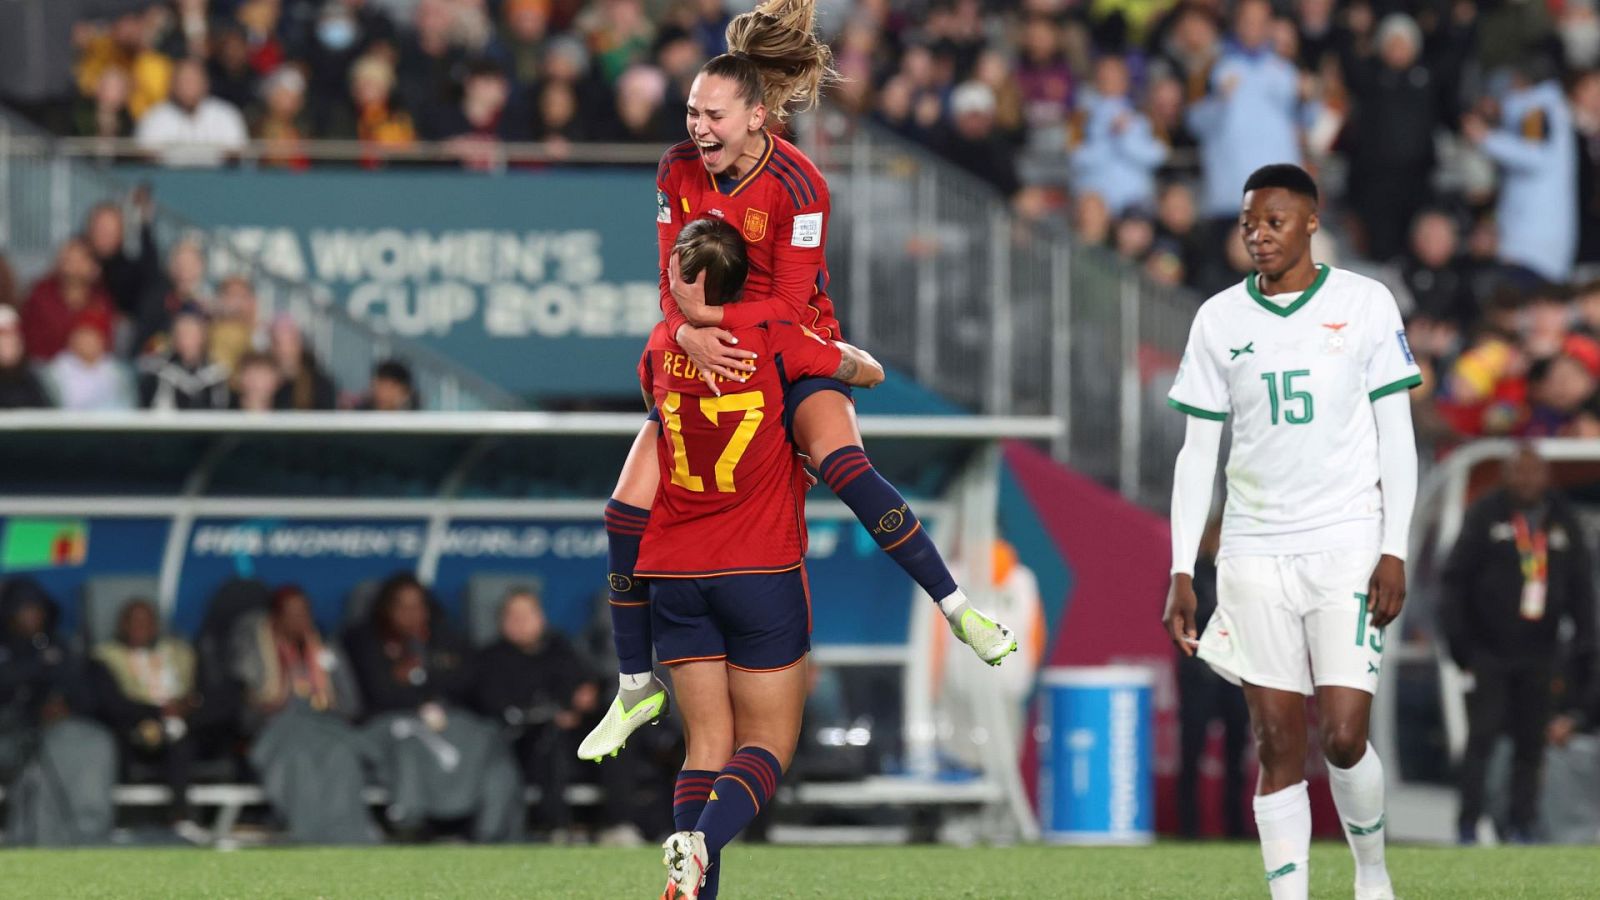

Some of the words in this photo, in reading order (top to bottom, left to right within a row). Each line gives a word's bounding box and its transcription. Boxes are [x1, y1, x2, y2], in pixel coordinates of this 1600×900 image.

[309, 228, 603, 284] WOMEN'S
[346, 281, 477, 337] CUP
[1261, 369, 1314, 425] 15
[662, 390, 764, 493] 17
